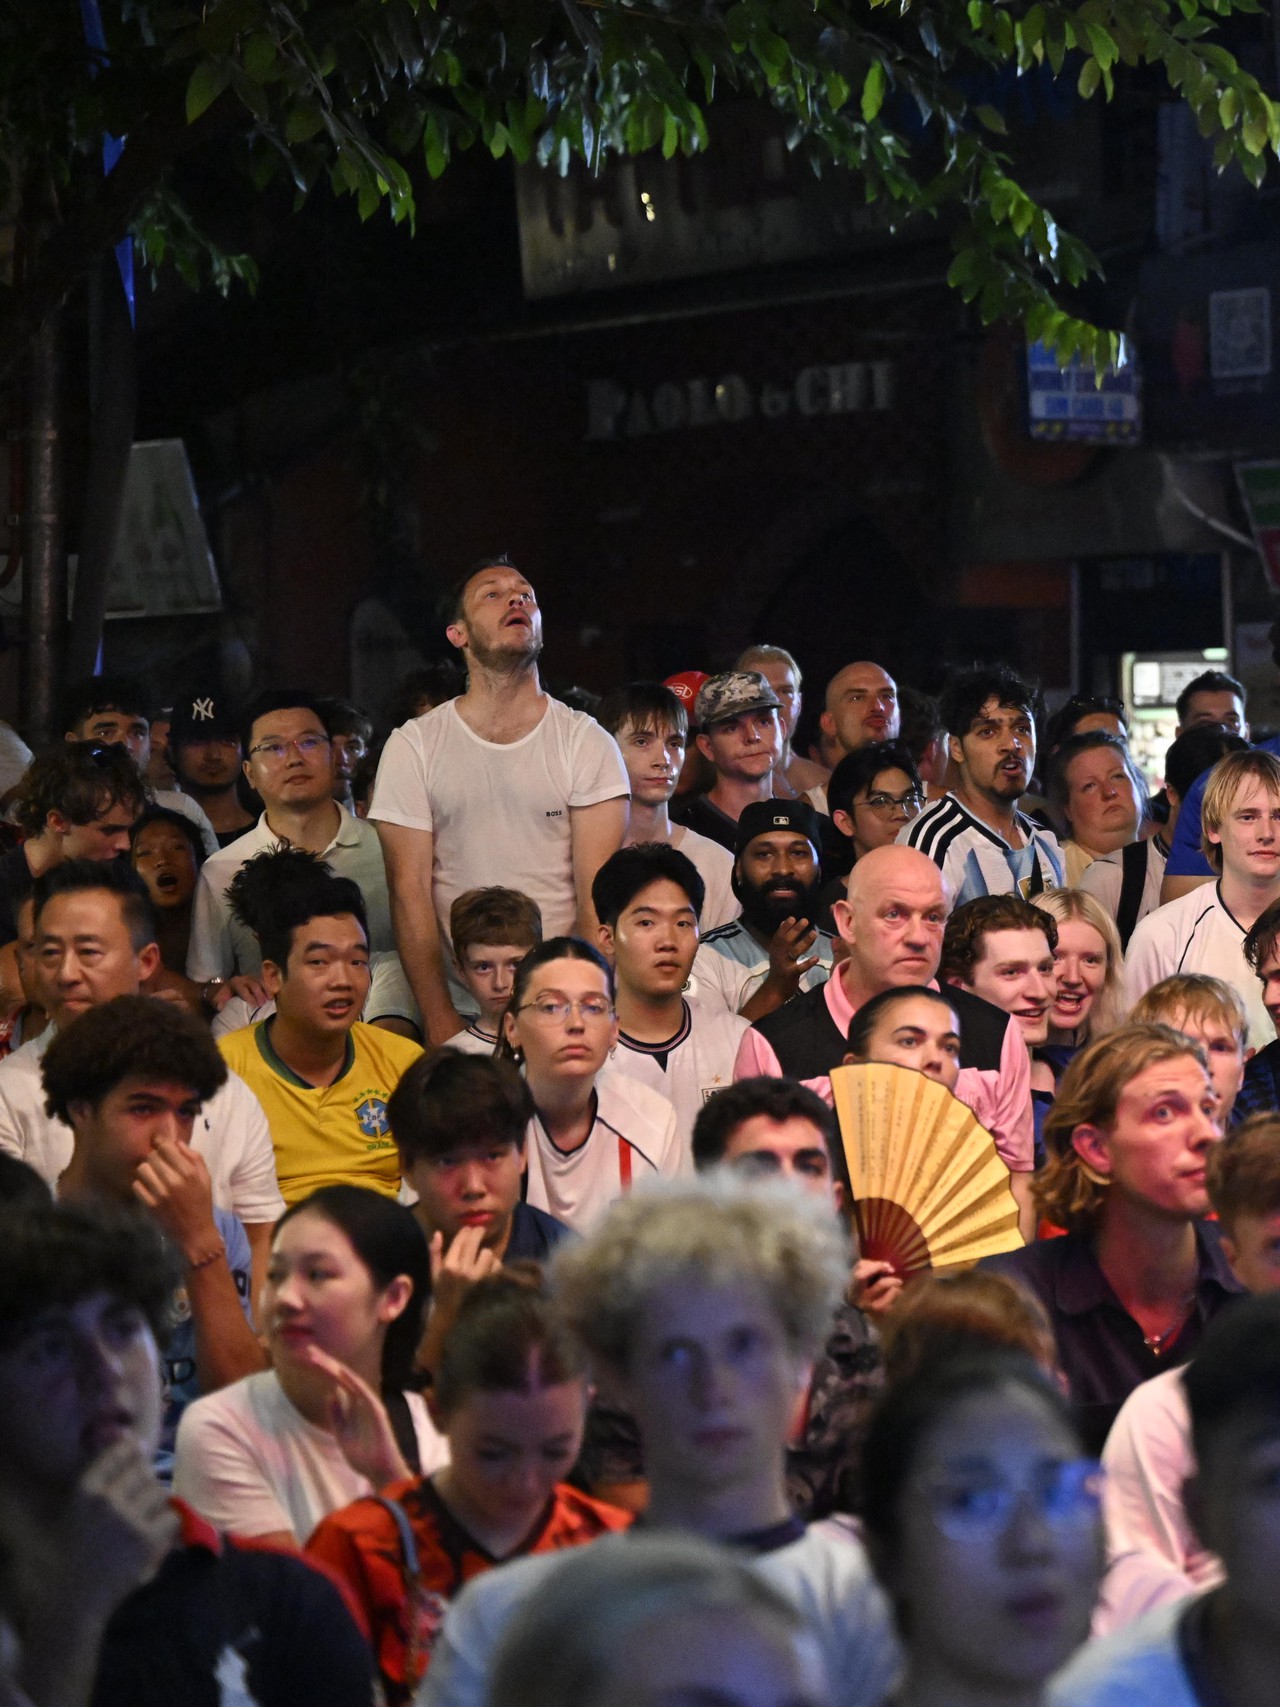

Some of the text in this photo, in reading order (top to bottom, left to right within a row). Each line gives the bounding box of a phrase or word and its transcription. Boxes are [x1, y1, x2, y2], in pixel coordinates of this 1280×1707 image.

[582, 372, 749, 442] PAOLO
[795, 359, 893, 416] CHI
[191, 697, 215, 721] NY
[545, 810, 562, 818] BOSS
